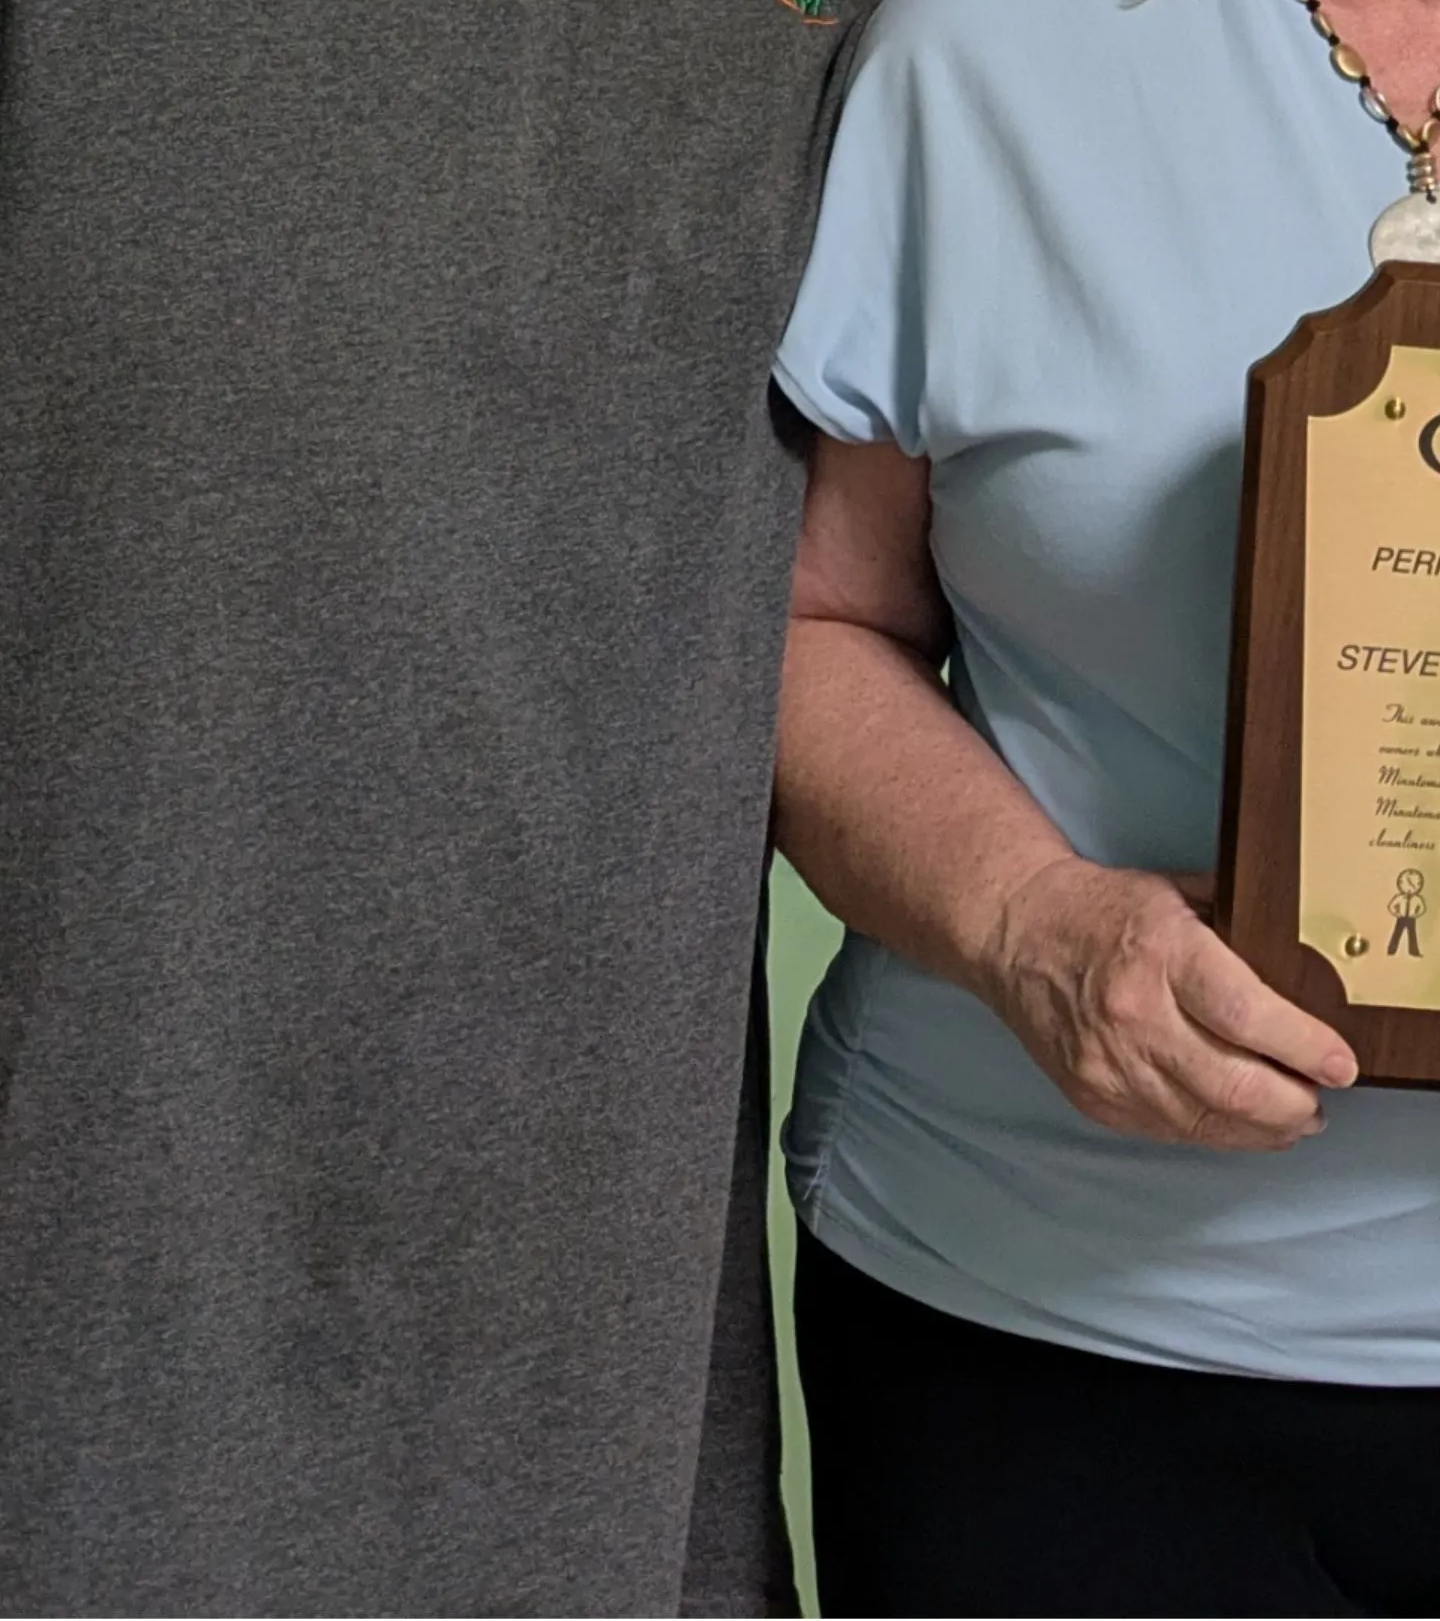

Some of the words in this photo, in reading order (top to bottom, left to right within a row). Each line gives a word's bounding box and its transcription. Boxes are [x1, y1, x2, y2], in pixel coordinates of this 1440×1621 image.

[1382, 703, 1414, 724] This
[1379, 744, 1420, 758] owners
[1368, 829, 1435, 852] cleanliness
